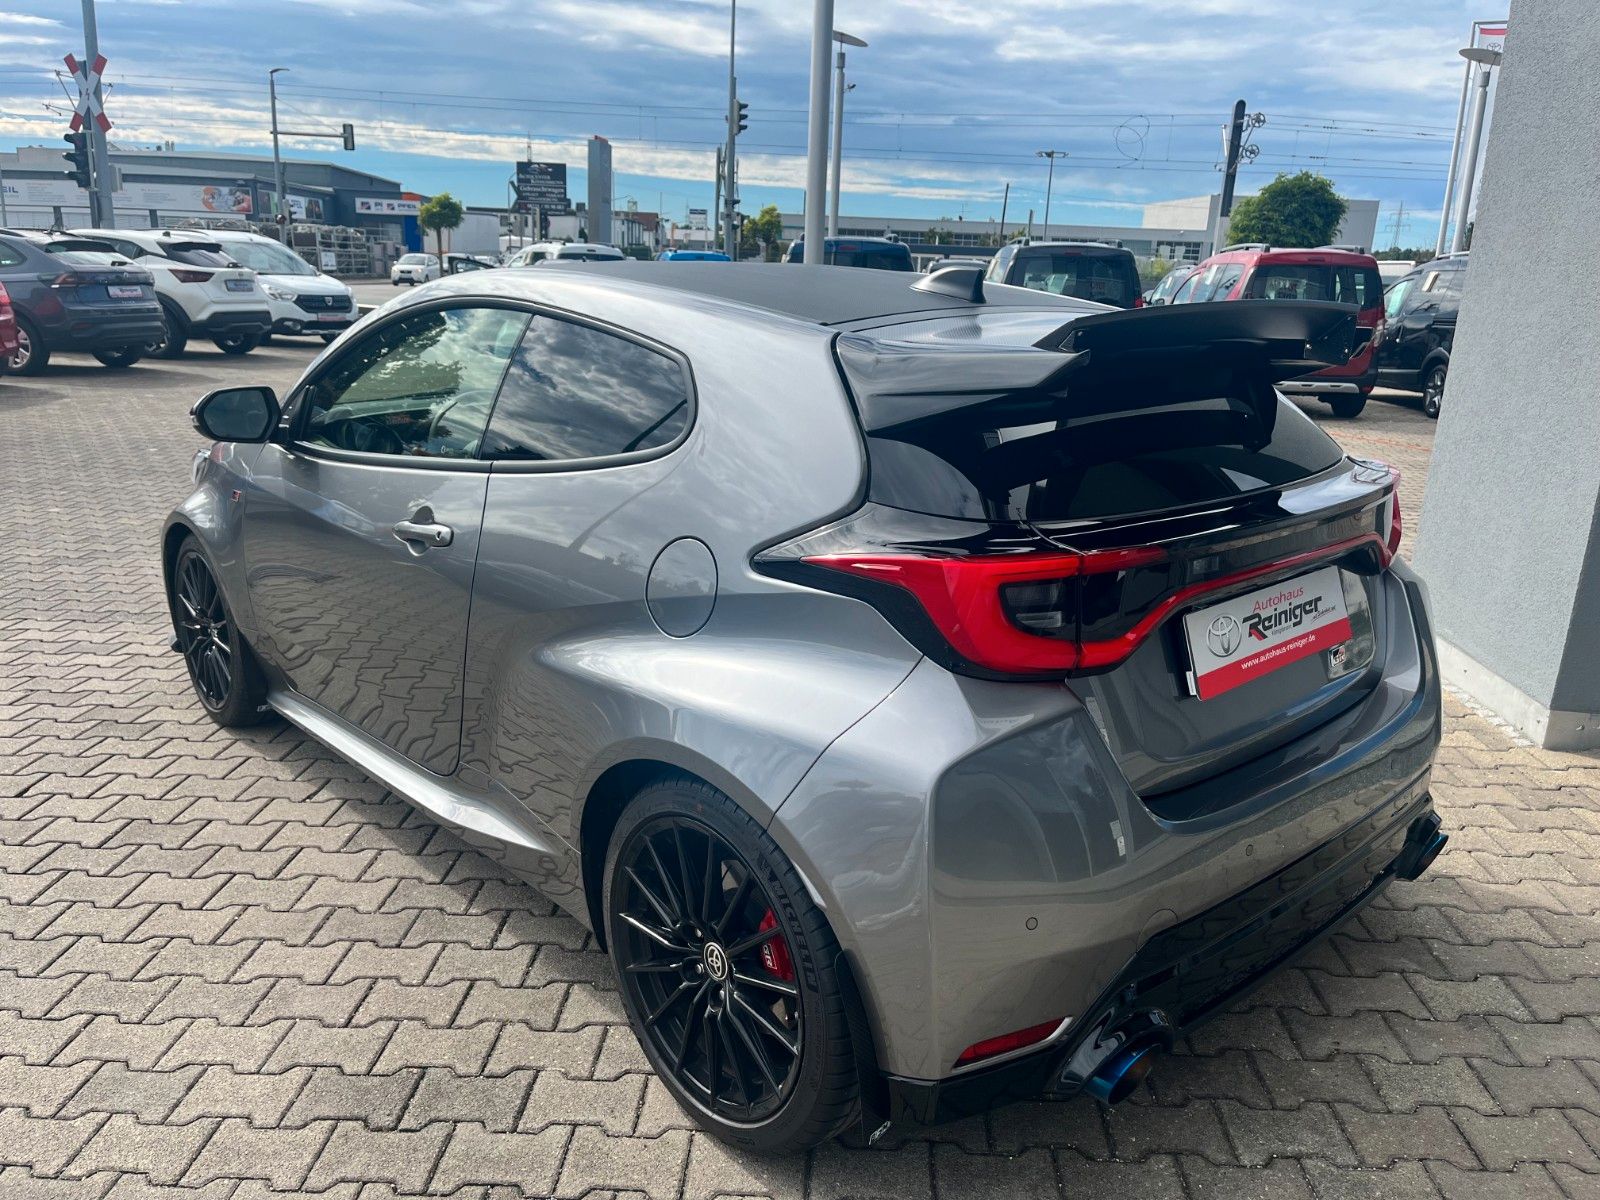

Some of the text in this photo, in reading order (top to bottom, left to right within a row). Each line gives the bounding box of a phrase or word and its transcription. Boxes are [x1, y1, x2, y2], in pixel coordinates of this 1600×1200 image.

[1252, 586, 1304, 614] Autohaus
[1242, 596, 1322, 641] Reiniger
[1241, 634, 1316, 670] www.autohaus-reiniger.de
